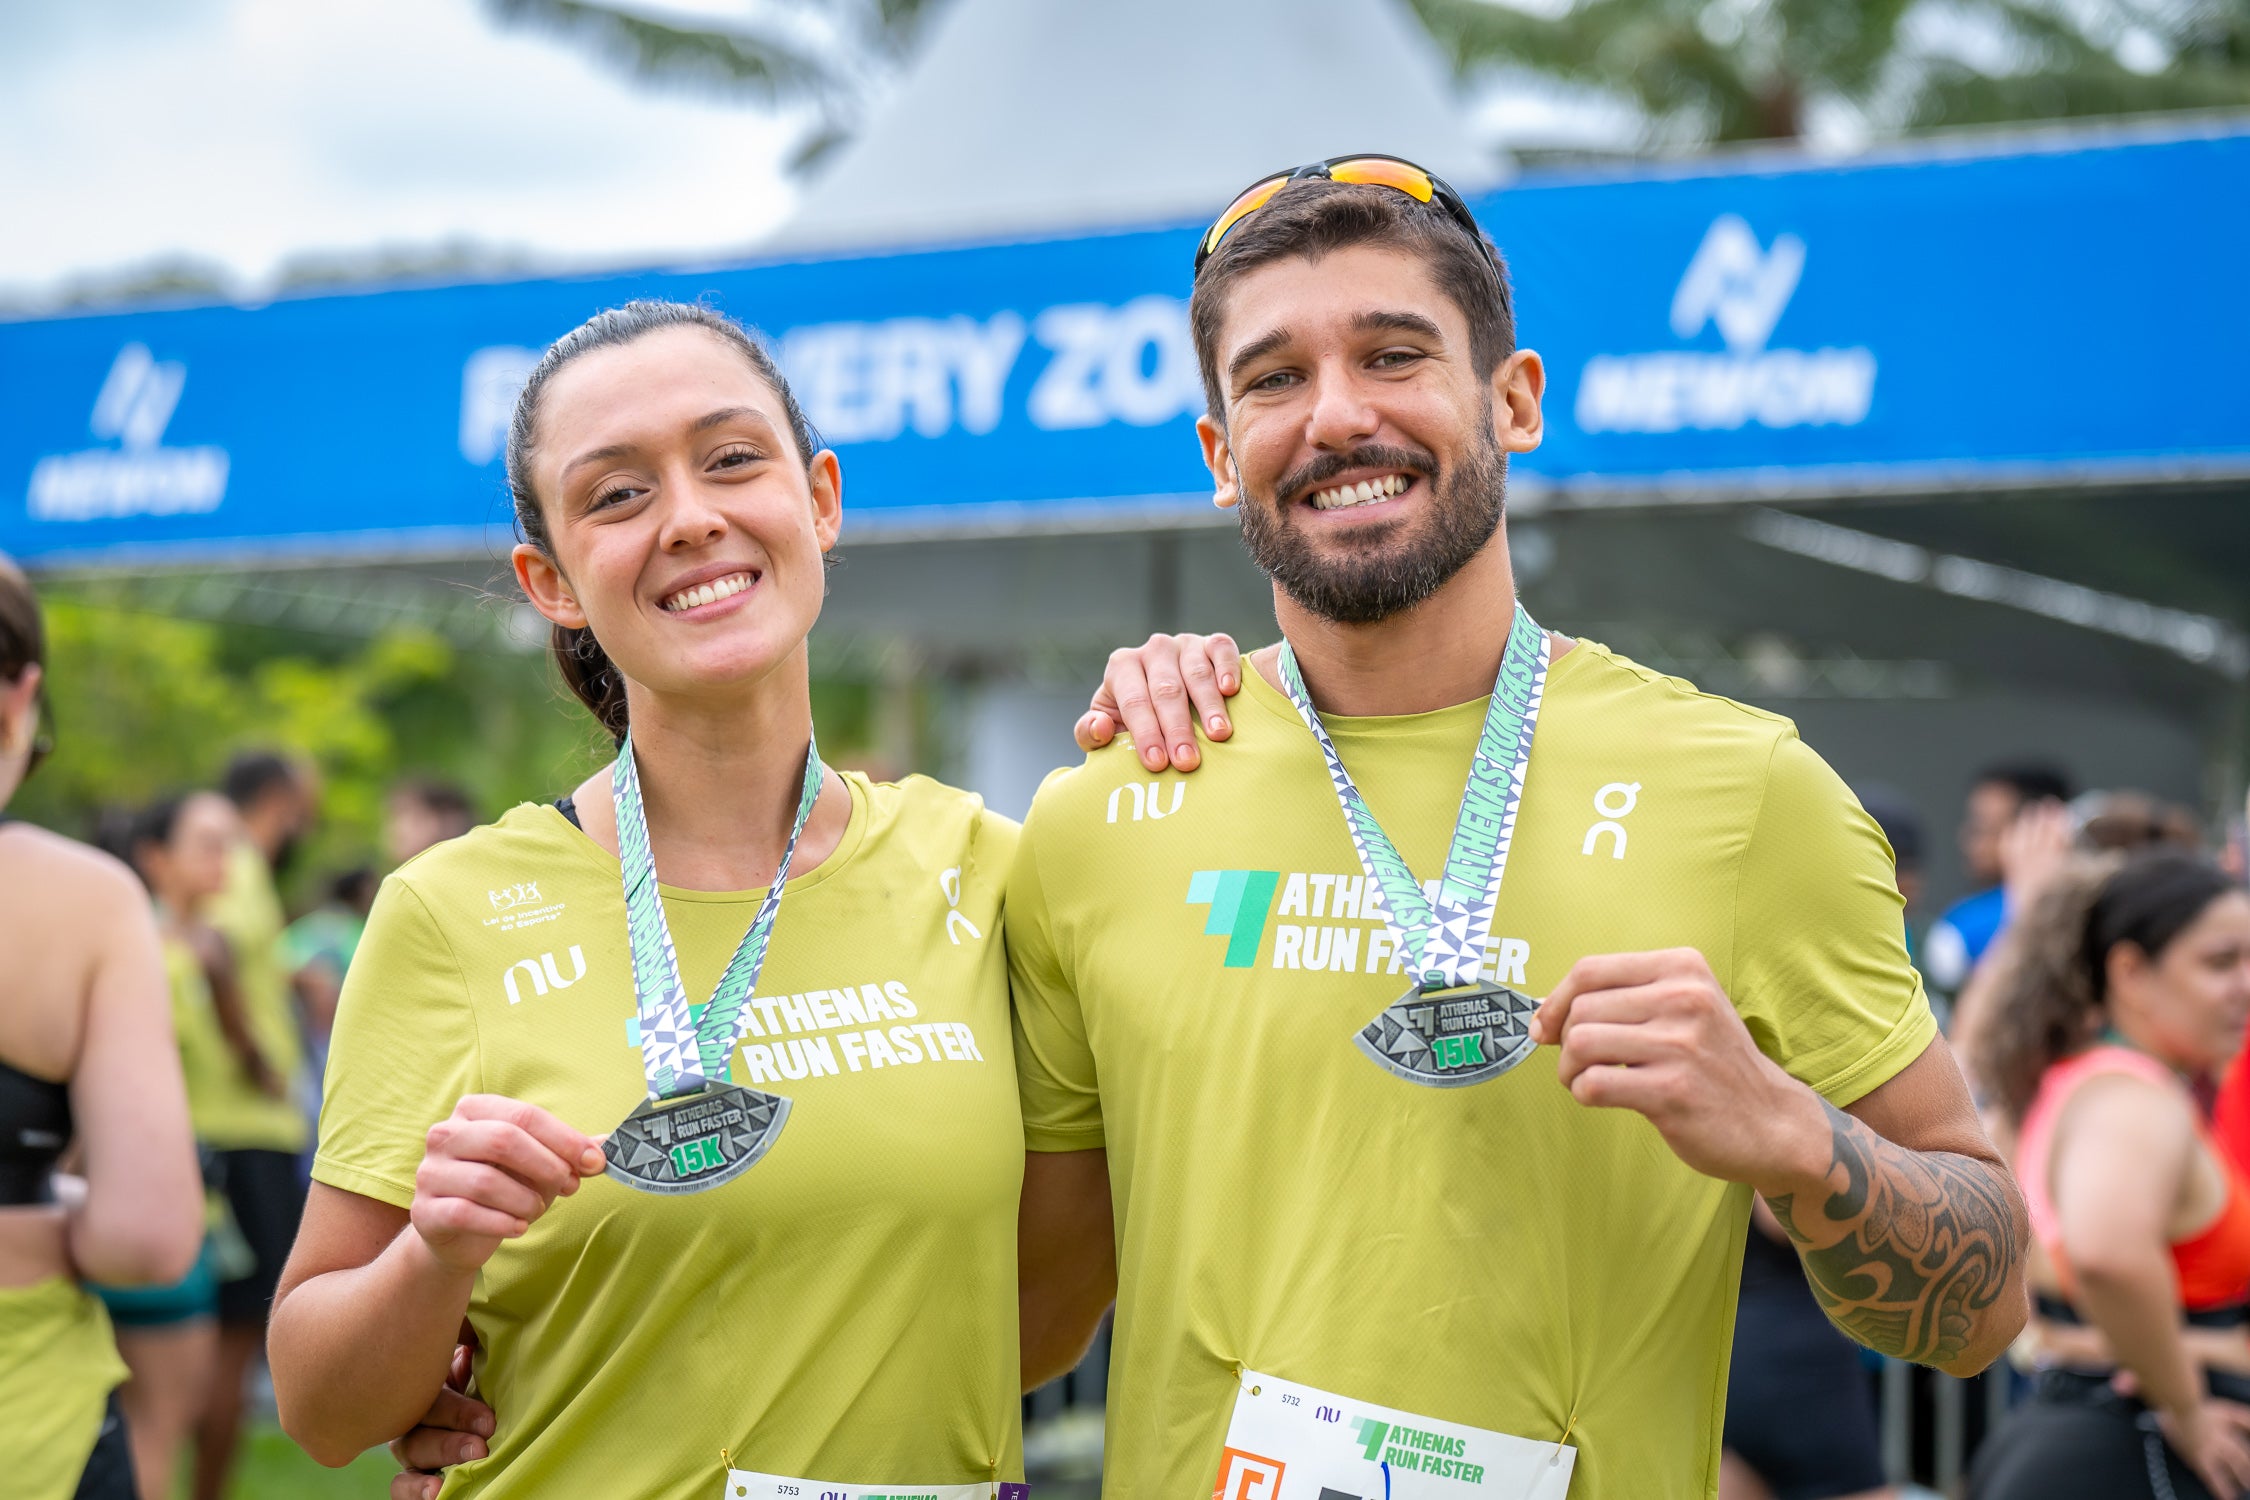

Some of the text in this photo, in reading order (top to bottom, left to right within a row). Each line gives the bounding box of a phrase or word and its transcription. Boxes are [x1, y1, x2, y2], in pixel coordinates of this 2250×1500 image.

[1026, 294, 1210, 431] ZO
[1446, 607, 1542, 888] ATHENAS RUN FASTER
[503, 914, 515, 922] de
[1272, 924, 1361, 973] RUN
[696, 934, 764, 1042] ATHENAS
[738, 980, 918, 1039] ATHENAS
[1440, 999, 1490, 1017] ATHENAS
[1441, 1010, 1507, 1032] RUN FASTER
[741, 1022, 984, 1084] RUN FASTER
[1431, 1031, 1487, 1070] 15K
[674, 1100, 725, 1125] ATHENAS
[677, 1109, 743, 1139] RUN FASTER
[669, 1133, 728, 1177] 15K
[1281, 1394, 1301, 1406] 5732
[1388, 1425, 1466, 1458] ATHENAS
[1384, 1446, 1485, 1485] RUN FASTER
[777, 1485, 800, 1496] 5753
